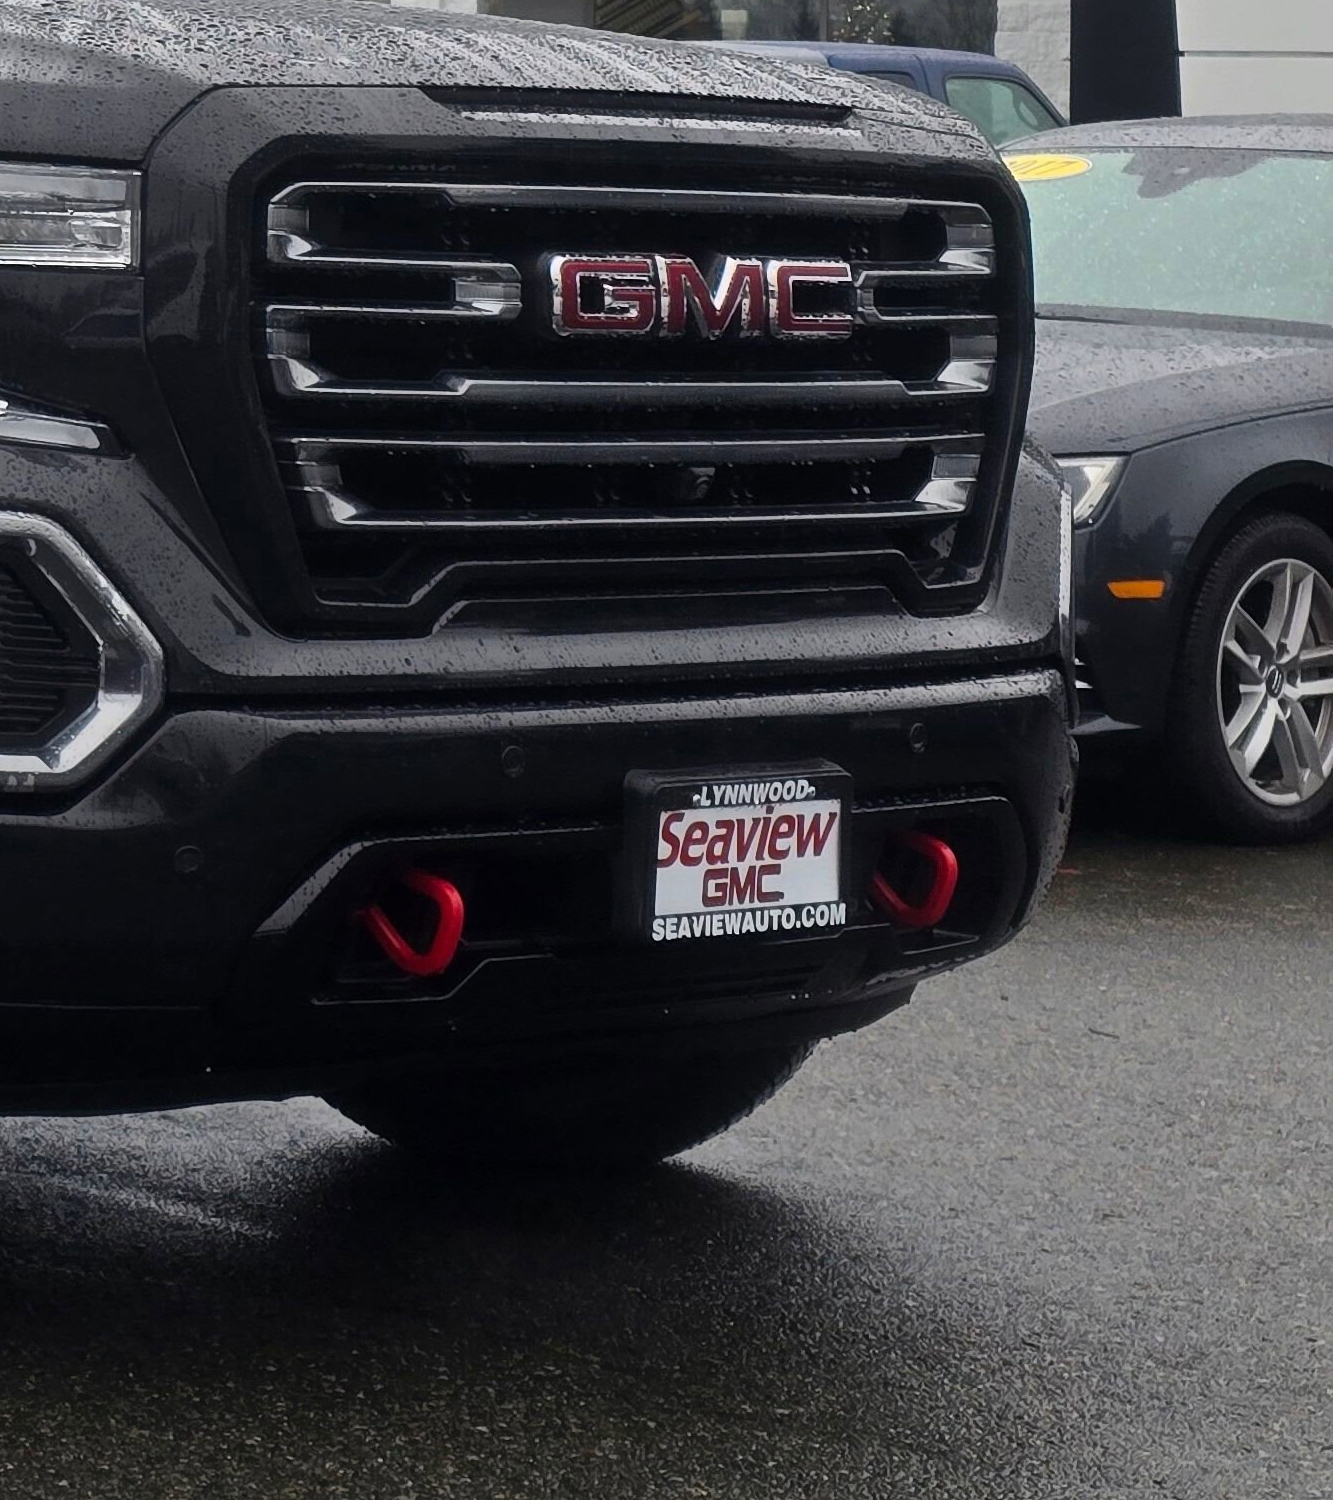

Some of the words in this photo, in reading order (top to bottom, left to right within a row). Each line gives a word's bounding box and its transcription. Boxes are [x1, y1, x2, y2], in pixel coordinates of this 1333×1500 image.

[550, 255, 853, 340] GMC
[700, 779, 810, 807] LYNNWOOD
[656, 806, 838, 869] Seaview
[701, 863, 785, 908] GMC
[652, 902, 847, 942] SEAVIEWAUTO.COM
